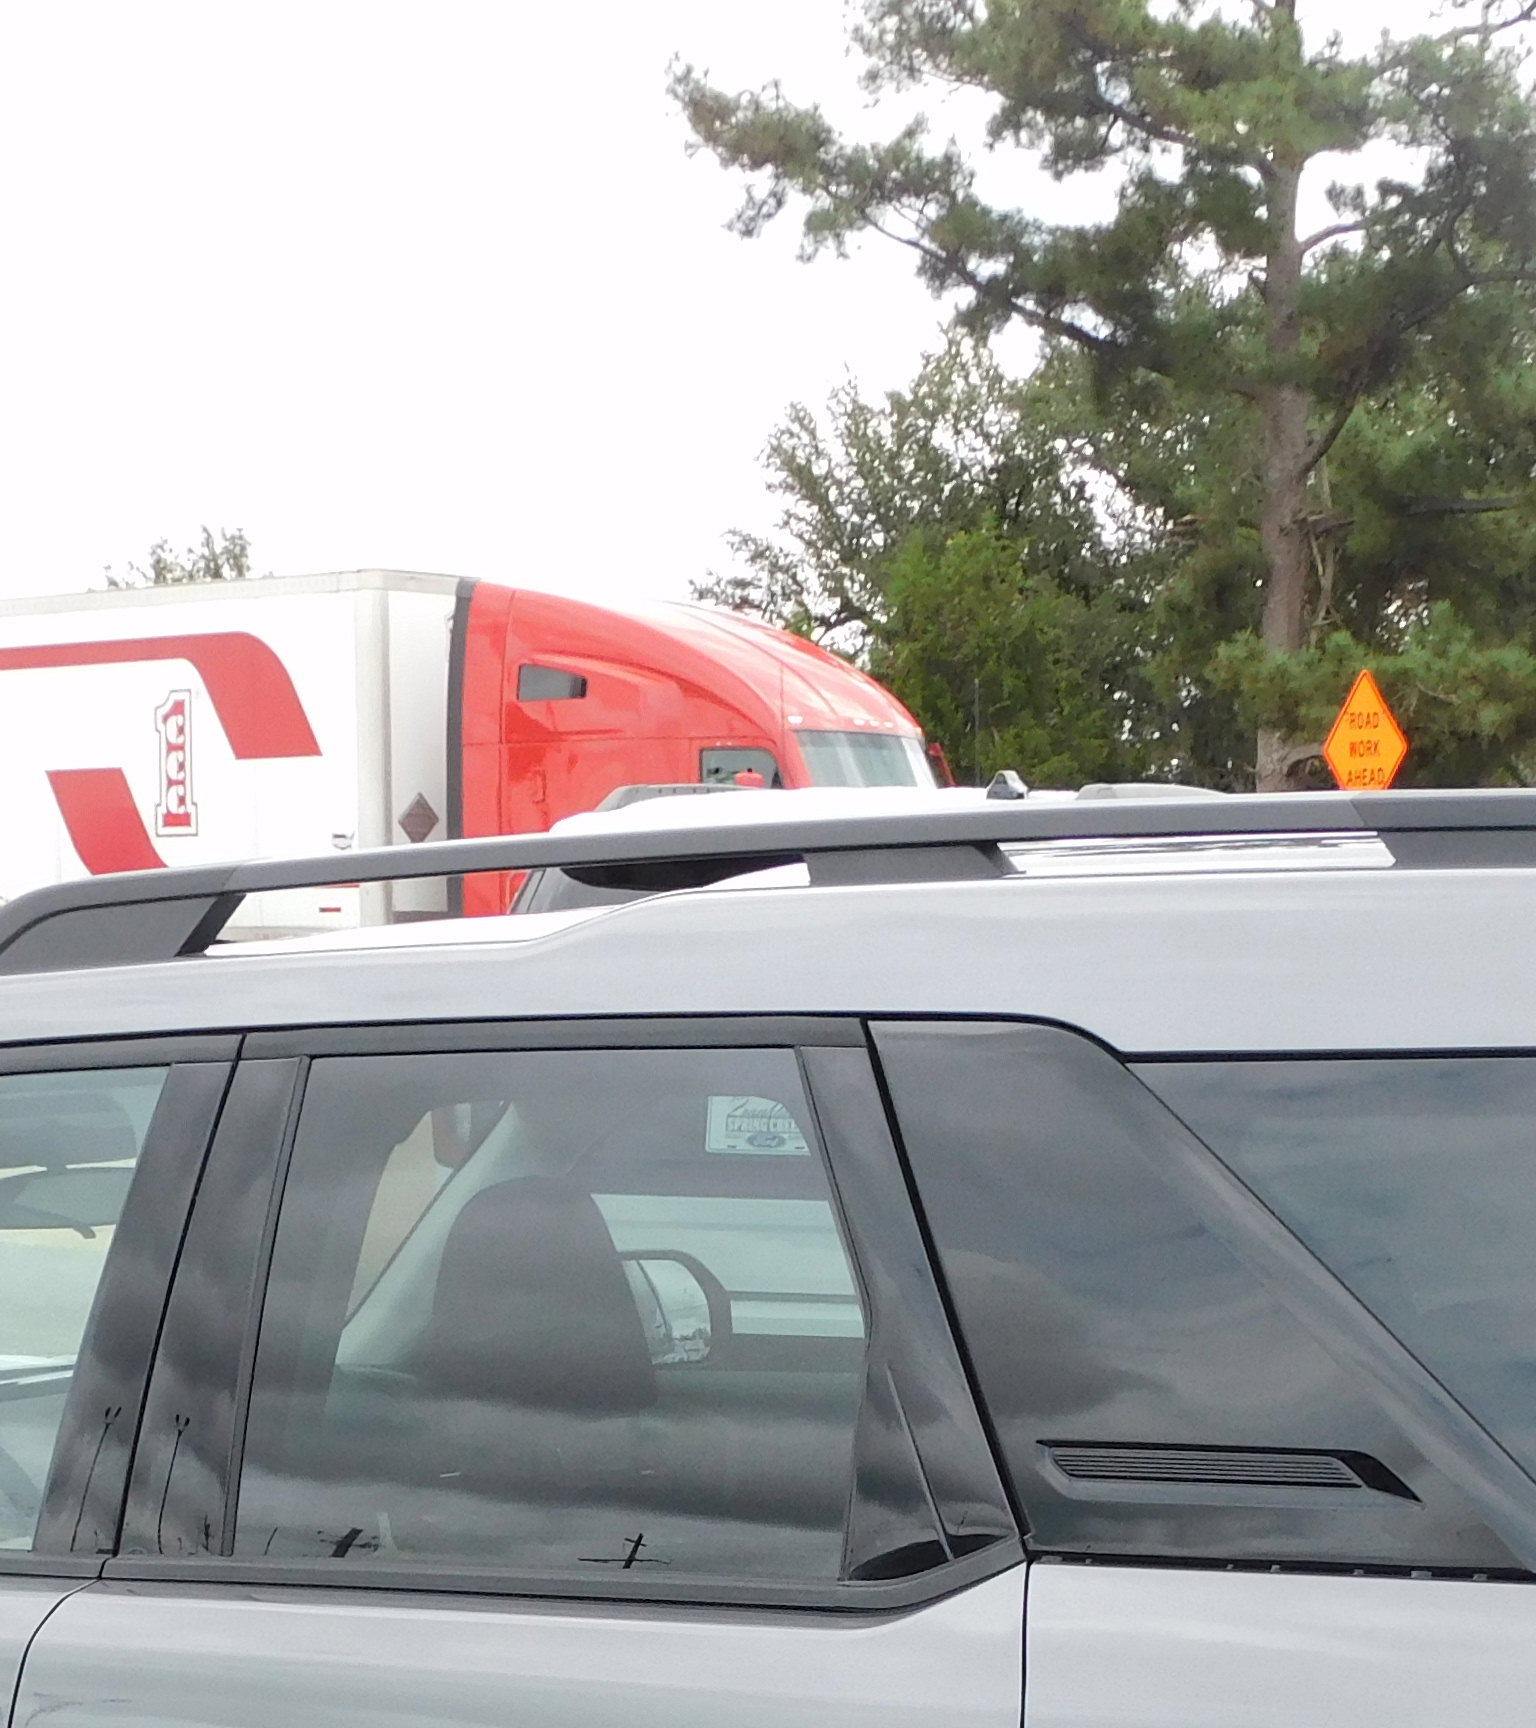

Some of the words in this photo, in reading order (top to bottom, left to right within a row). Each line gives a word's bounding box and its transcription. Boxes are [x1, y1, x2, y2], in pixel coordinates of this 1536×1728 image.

[1349, 711, 1380, 730] ROAD
[1349, 739, 1380, 758] WORK
[1346, 767, 1385, 786] AHEAD
